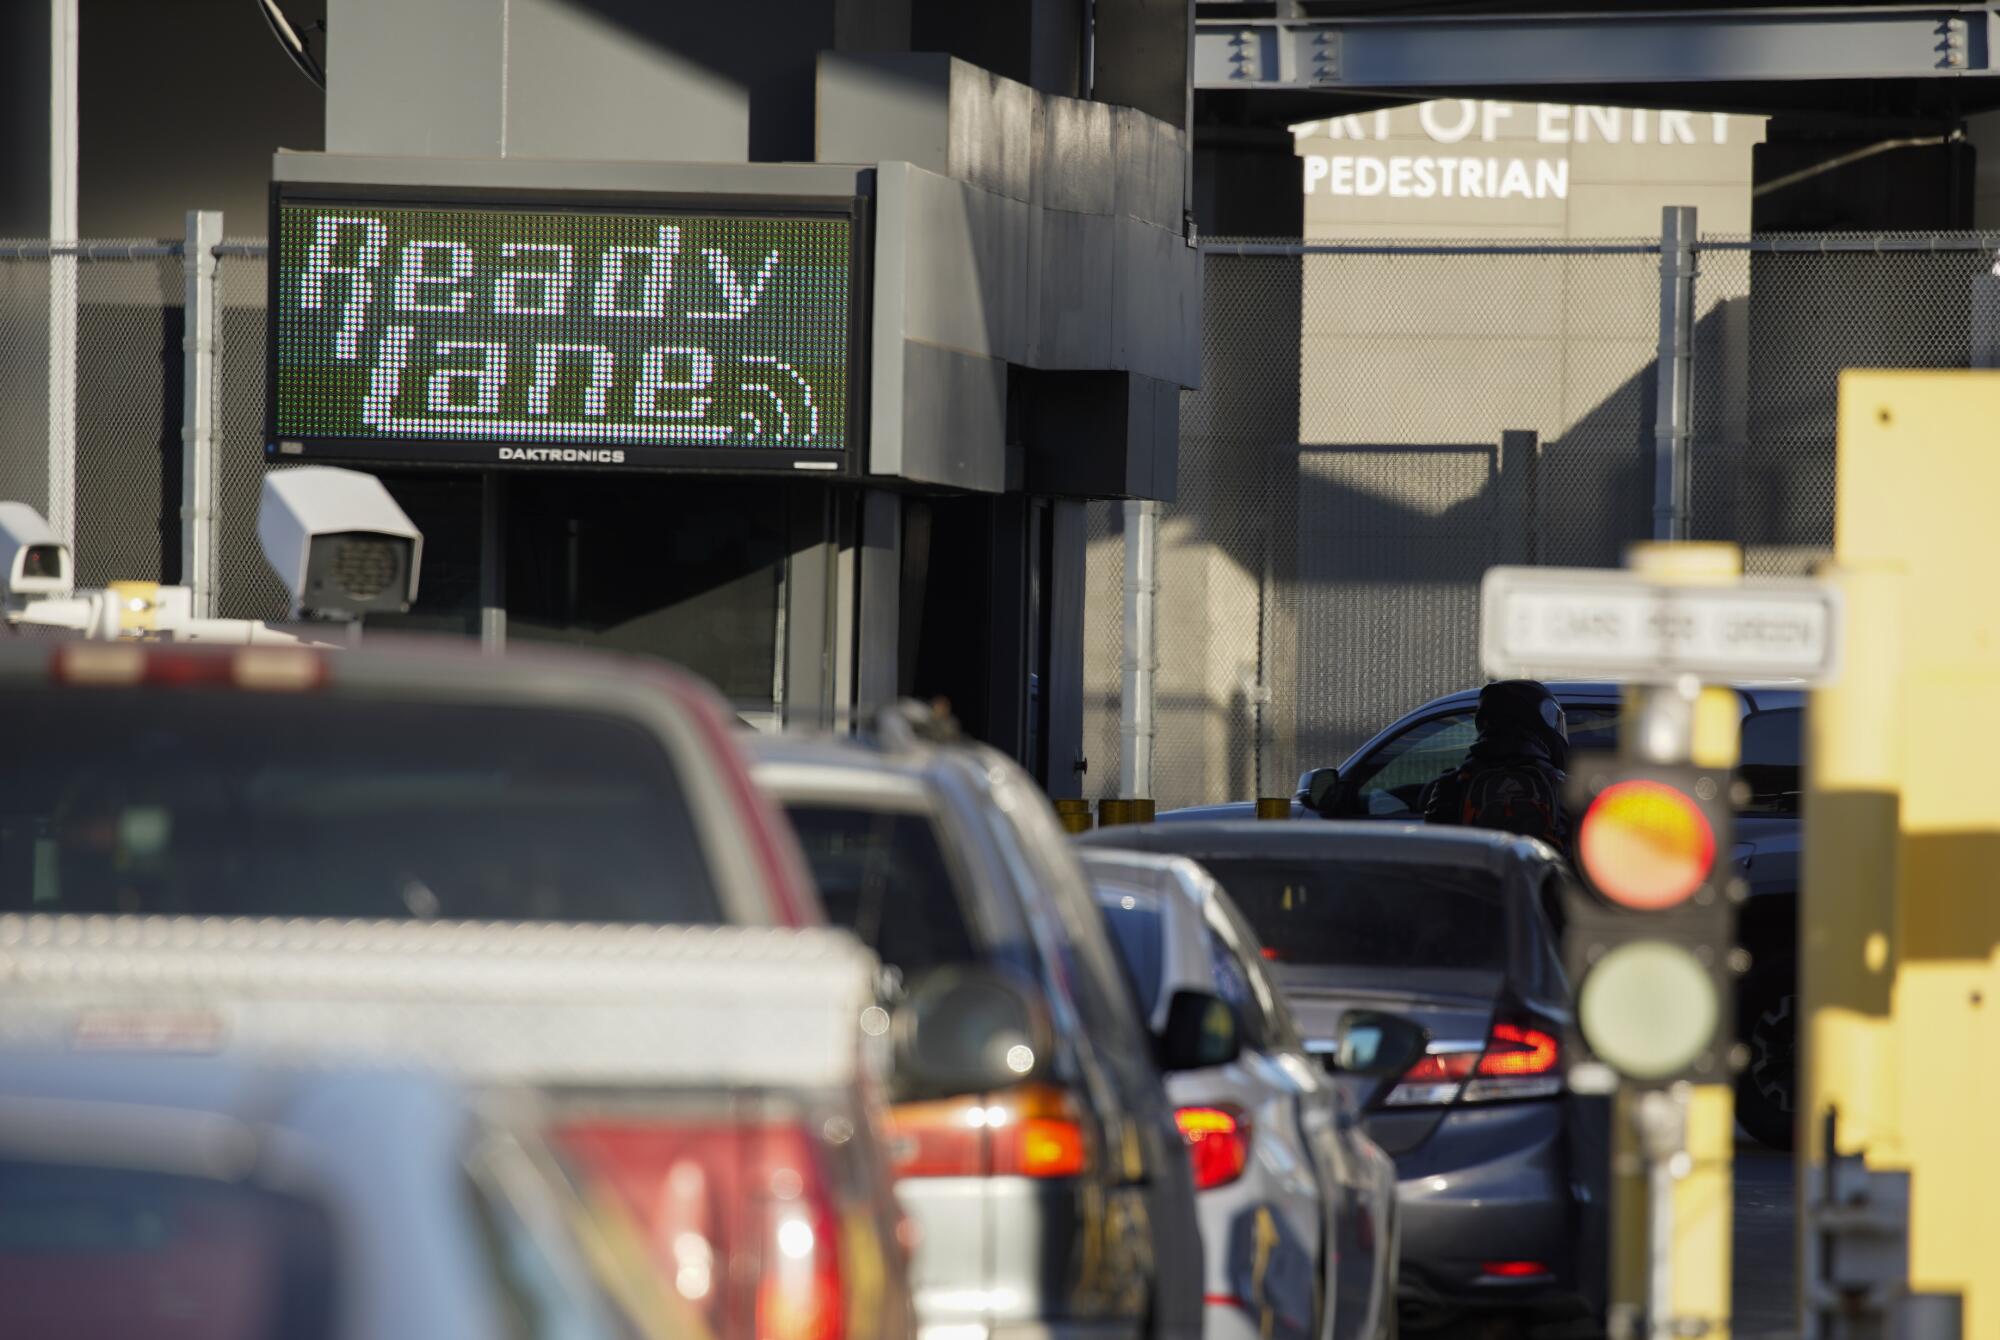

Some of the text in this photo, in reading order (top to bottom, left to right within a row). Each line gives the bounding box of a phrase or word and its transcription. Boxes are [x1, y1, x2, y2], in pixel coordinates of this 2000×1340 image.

[1304, 155, 1569, 199] PEDESTRIAN
[301, 215, 780, 360] Ready
[362, 325, 733, 440] Lane
[498, 447, 625, 464] DAKTRONICS
